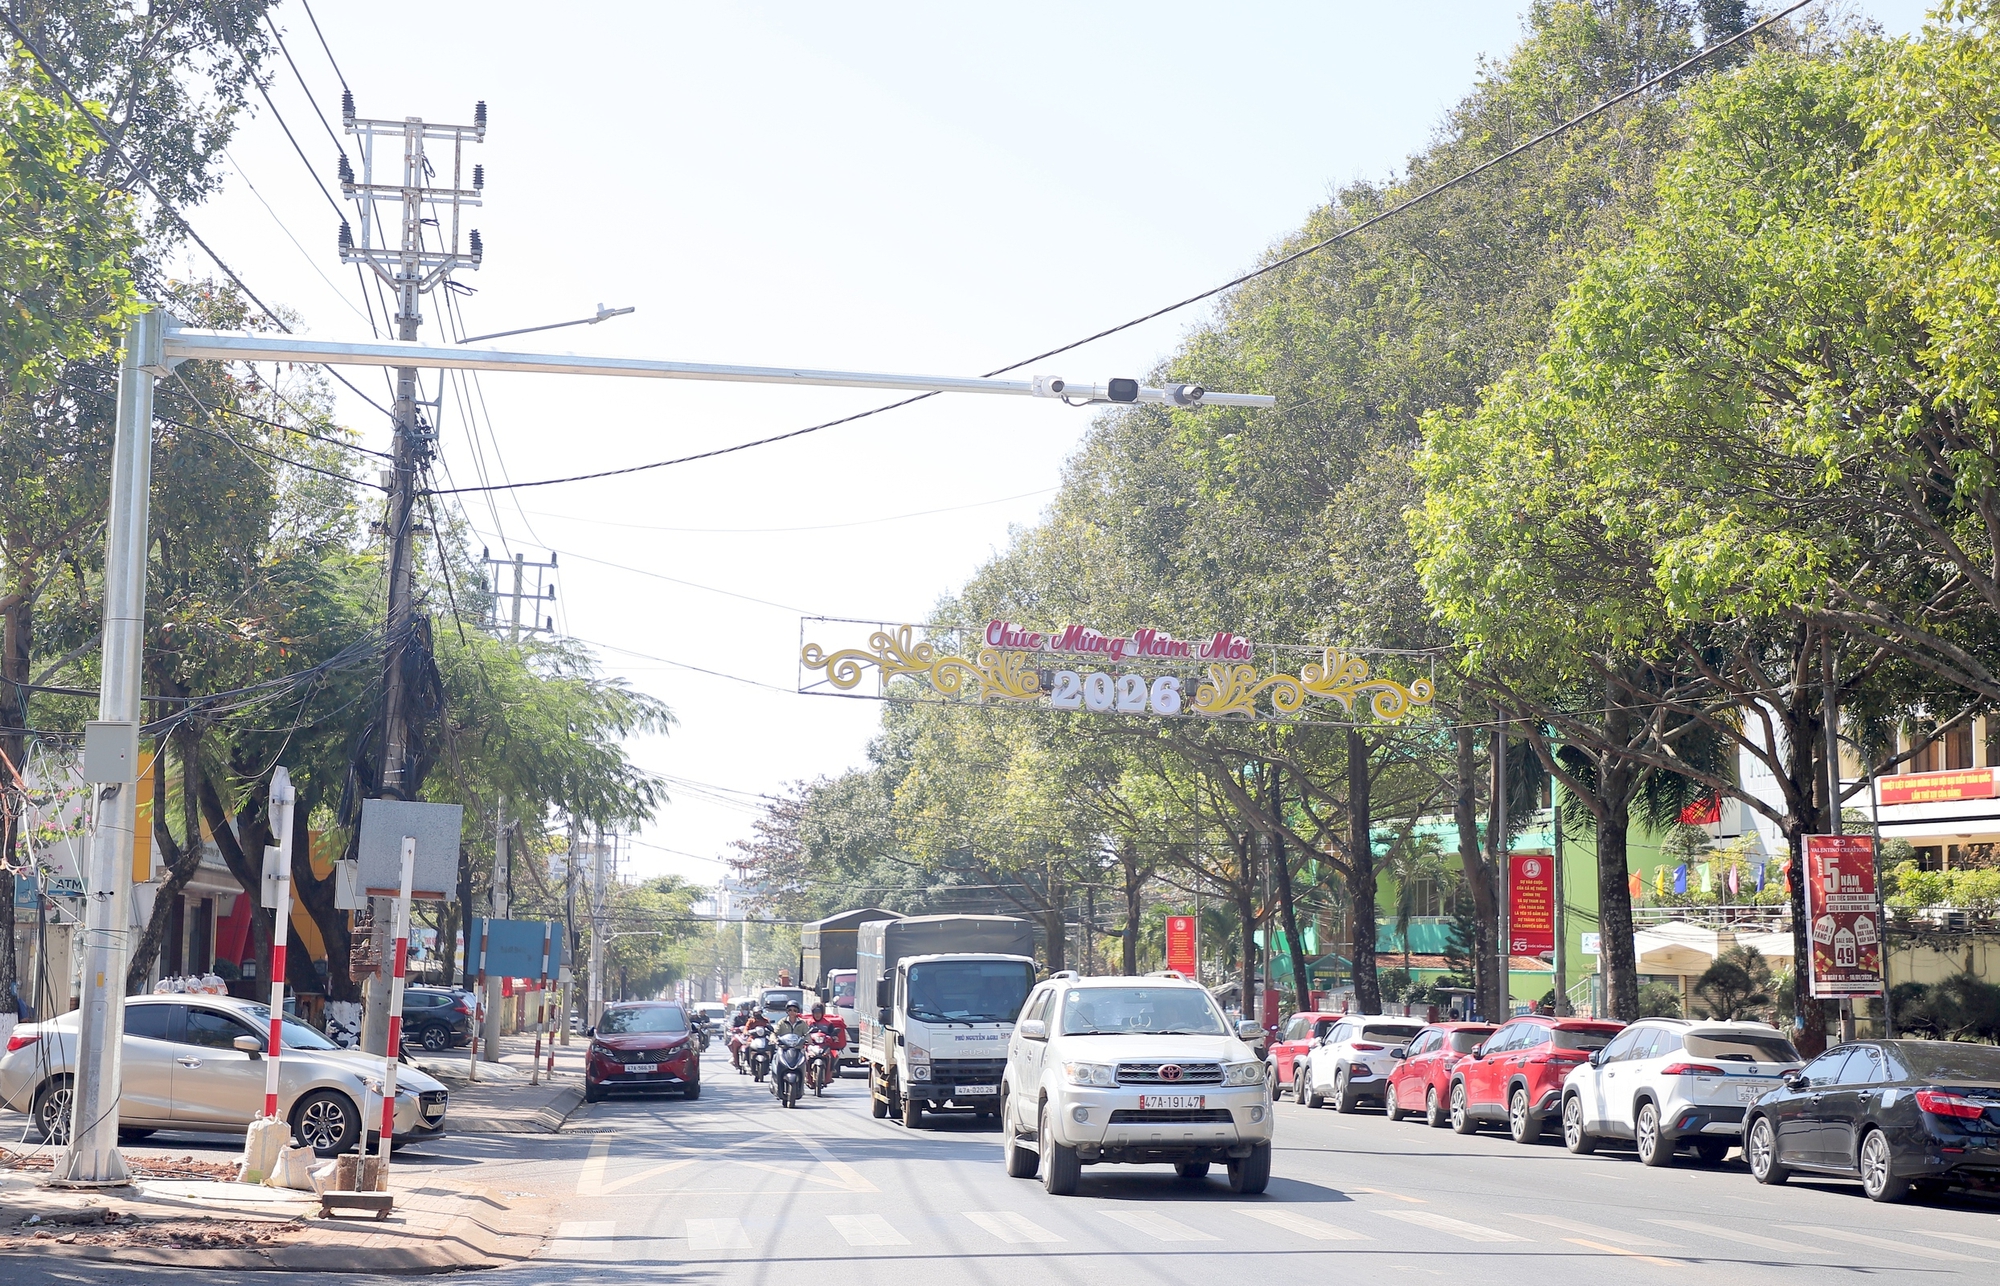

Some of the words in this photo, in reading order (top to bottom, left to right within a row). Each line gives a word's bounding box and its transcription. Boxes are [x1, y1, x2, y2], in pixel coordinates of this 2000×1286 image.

[986, 619, 1042, 648] Chúc
[1051, 624, 1127, 661] Mừng
[1133, 628, 1191, 658] Năm
[1200, 632, 1253, 660] Mới
[1052, 671, 1181, 715] 2026
[1823, 857, 1840, 893] 5
[1841, 874, 1859, 886] NĂM
[56, 879, 82, 889] ATM
[1817, 922, 1829, 932] MUA
[1512, 941, 1527, 951] 5G
[1145, 1096, 1199, 1108] 47A-191.47
